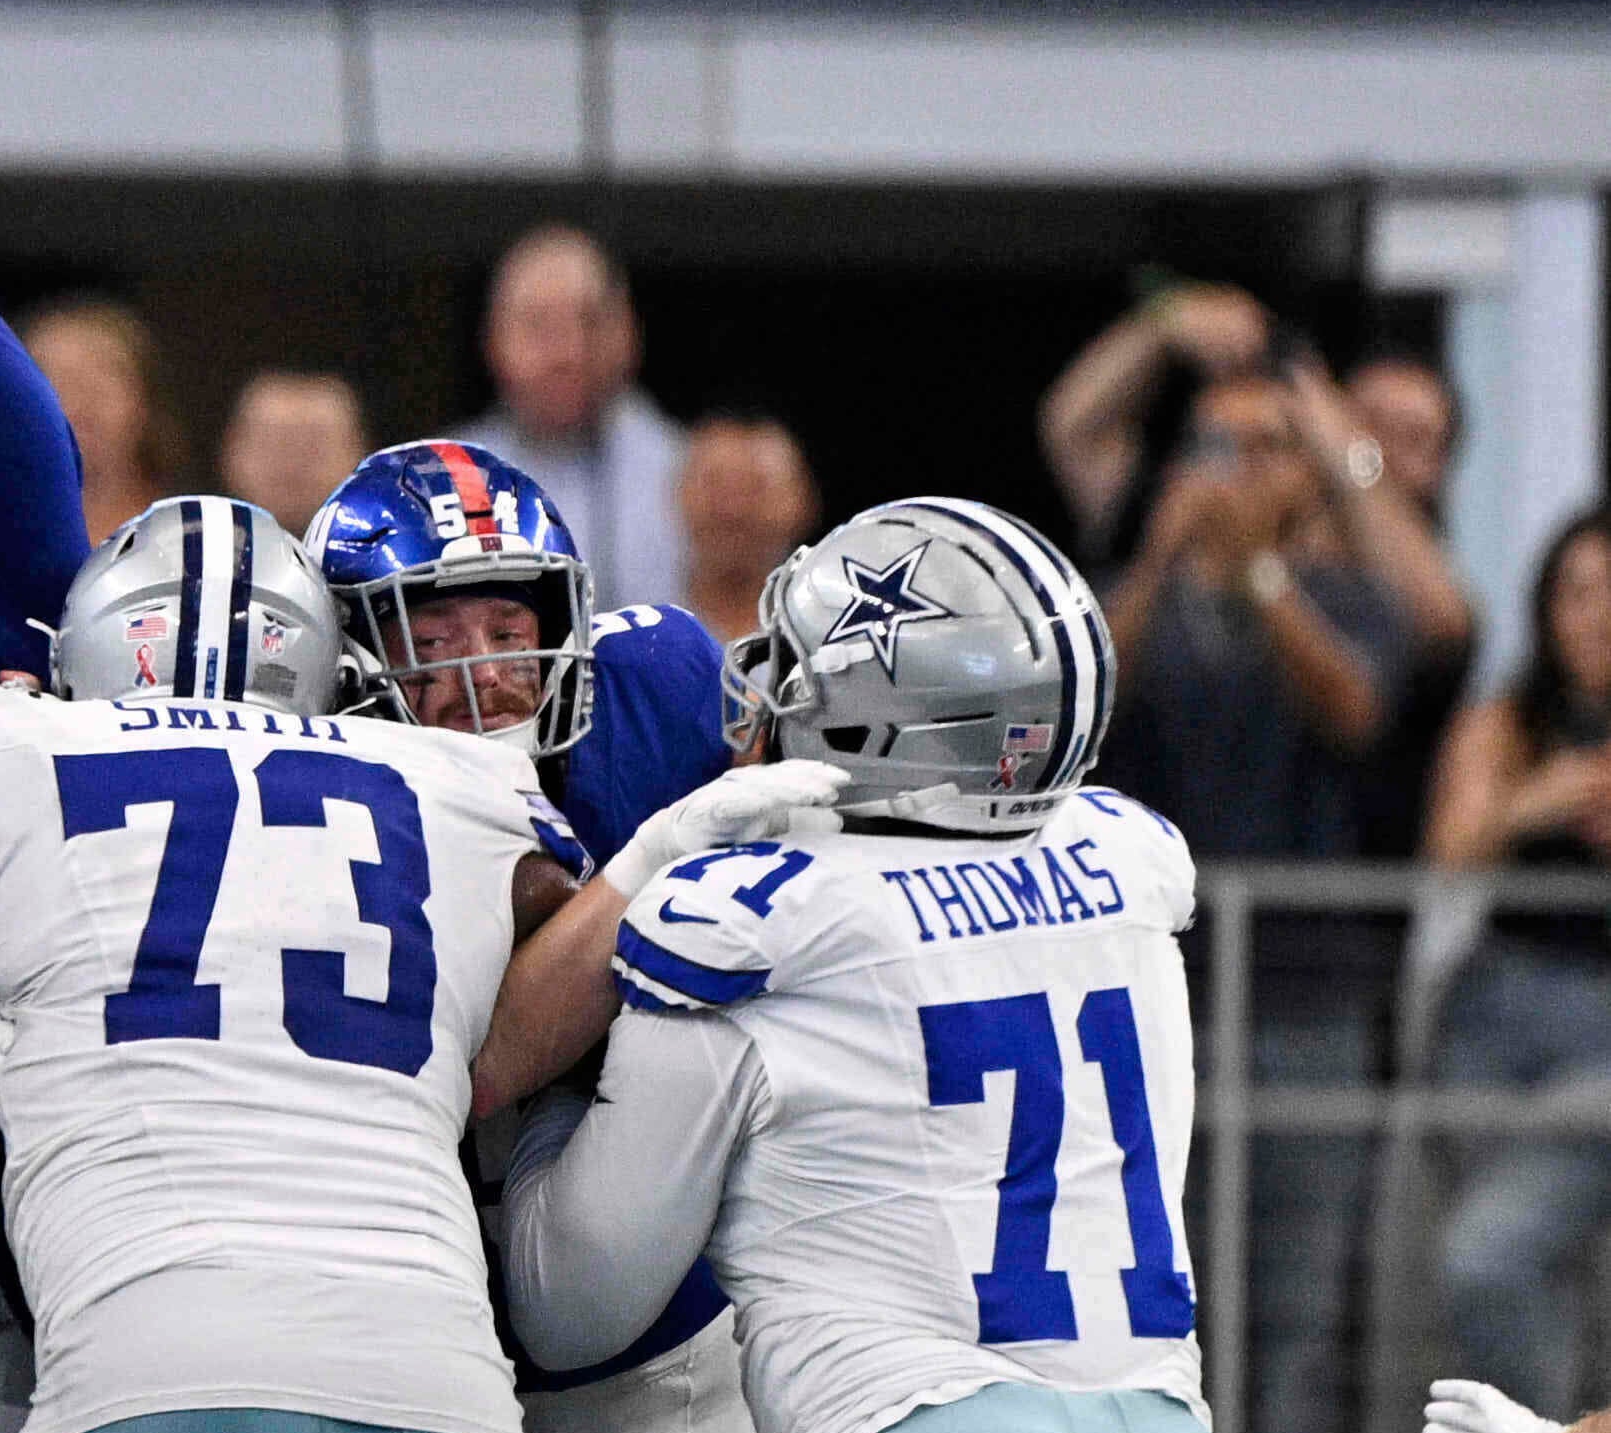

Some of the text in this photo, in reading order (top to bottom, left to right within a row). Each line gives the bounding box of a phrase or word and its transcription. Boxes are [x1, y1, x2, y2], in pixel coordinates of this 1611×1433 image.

[52, 747, 438, 1078] 73
[880, 839, 1126, 943] THOMAS
[917, 985, 1195, 1345] 71
